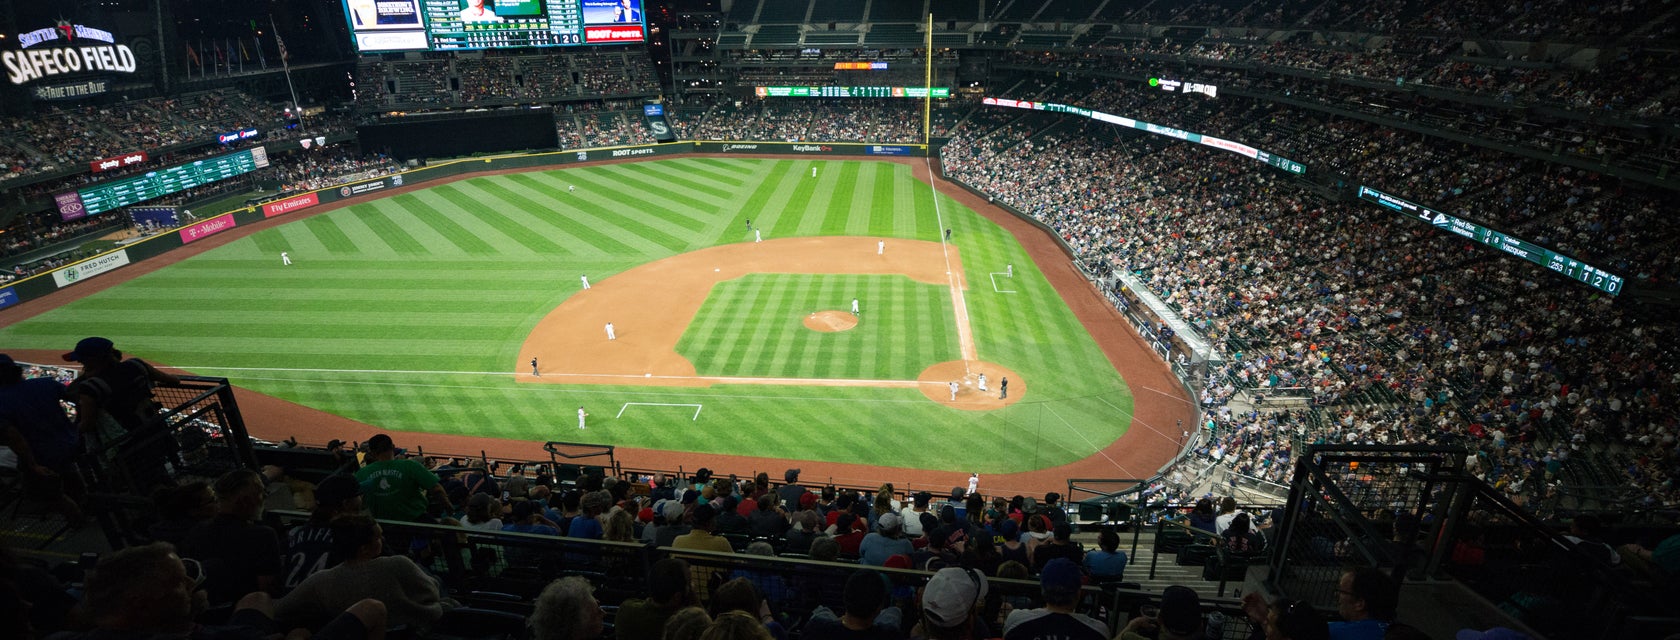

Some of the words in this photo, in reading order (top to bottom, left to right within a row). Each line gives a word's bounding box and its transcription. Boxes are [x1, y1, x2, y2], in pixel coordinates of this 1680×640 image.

[553, 35, 558, 44] 1
[563, 35, 569, 43] 2
[572, 34, 579, 42] 0
[588, 30, 611, 38] ROOT
[2, 47, 81, 85] SAFECO
[80, 44, 136, 72] FIELD
[45, 87, 65, 98] TRUE
[65, 86, 74, 97] TO
[75, 84, 88, 96] THE
[89, 82, 106, 94] BLUE
[226, 134, 238, 142] pepsi
[246, 129, 258, 137] pepsi
[100, 160, 119, 170] xfinity
[124, 154, 142, 164] xfinity
[271, 204, 284, 213] Fly
[285, 198, 311, 208] Emirates
[1455, 219, 1465, 228] Red
[1466, 223, 1475, 231] Sox
[1452, 226, 1473, 238] Mariners
[1502, 243, 1528, 258] Vazquez
[80, 262, 97, 272] FRED
[98, 255, 119, 265] HUTCH
[1594, 276, 1602, 286] 2
[1609, 282, 1616, 292] 0
[1610, 275, 1620, 283] Out
[288, 528, 333, 548] GRIFF
[284, 552, 328, 588] 24
